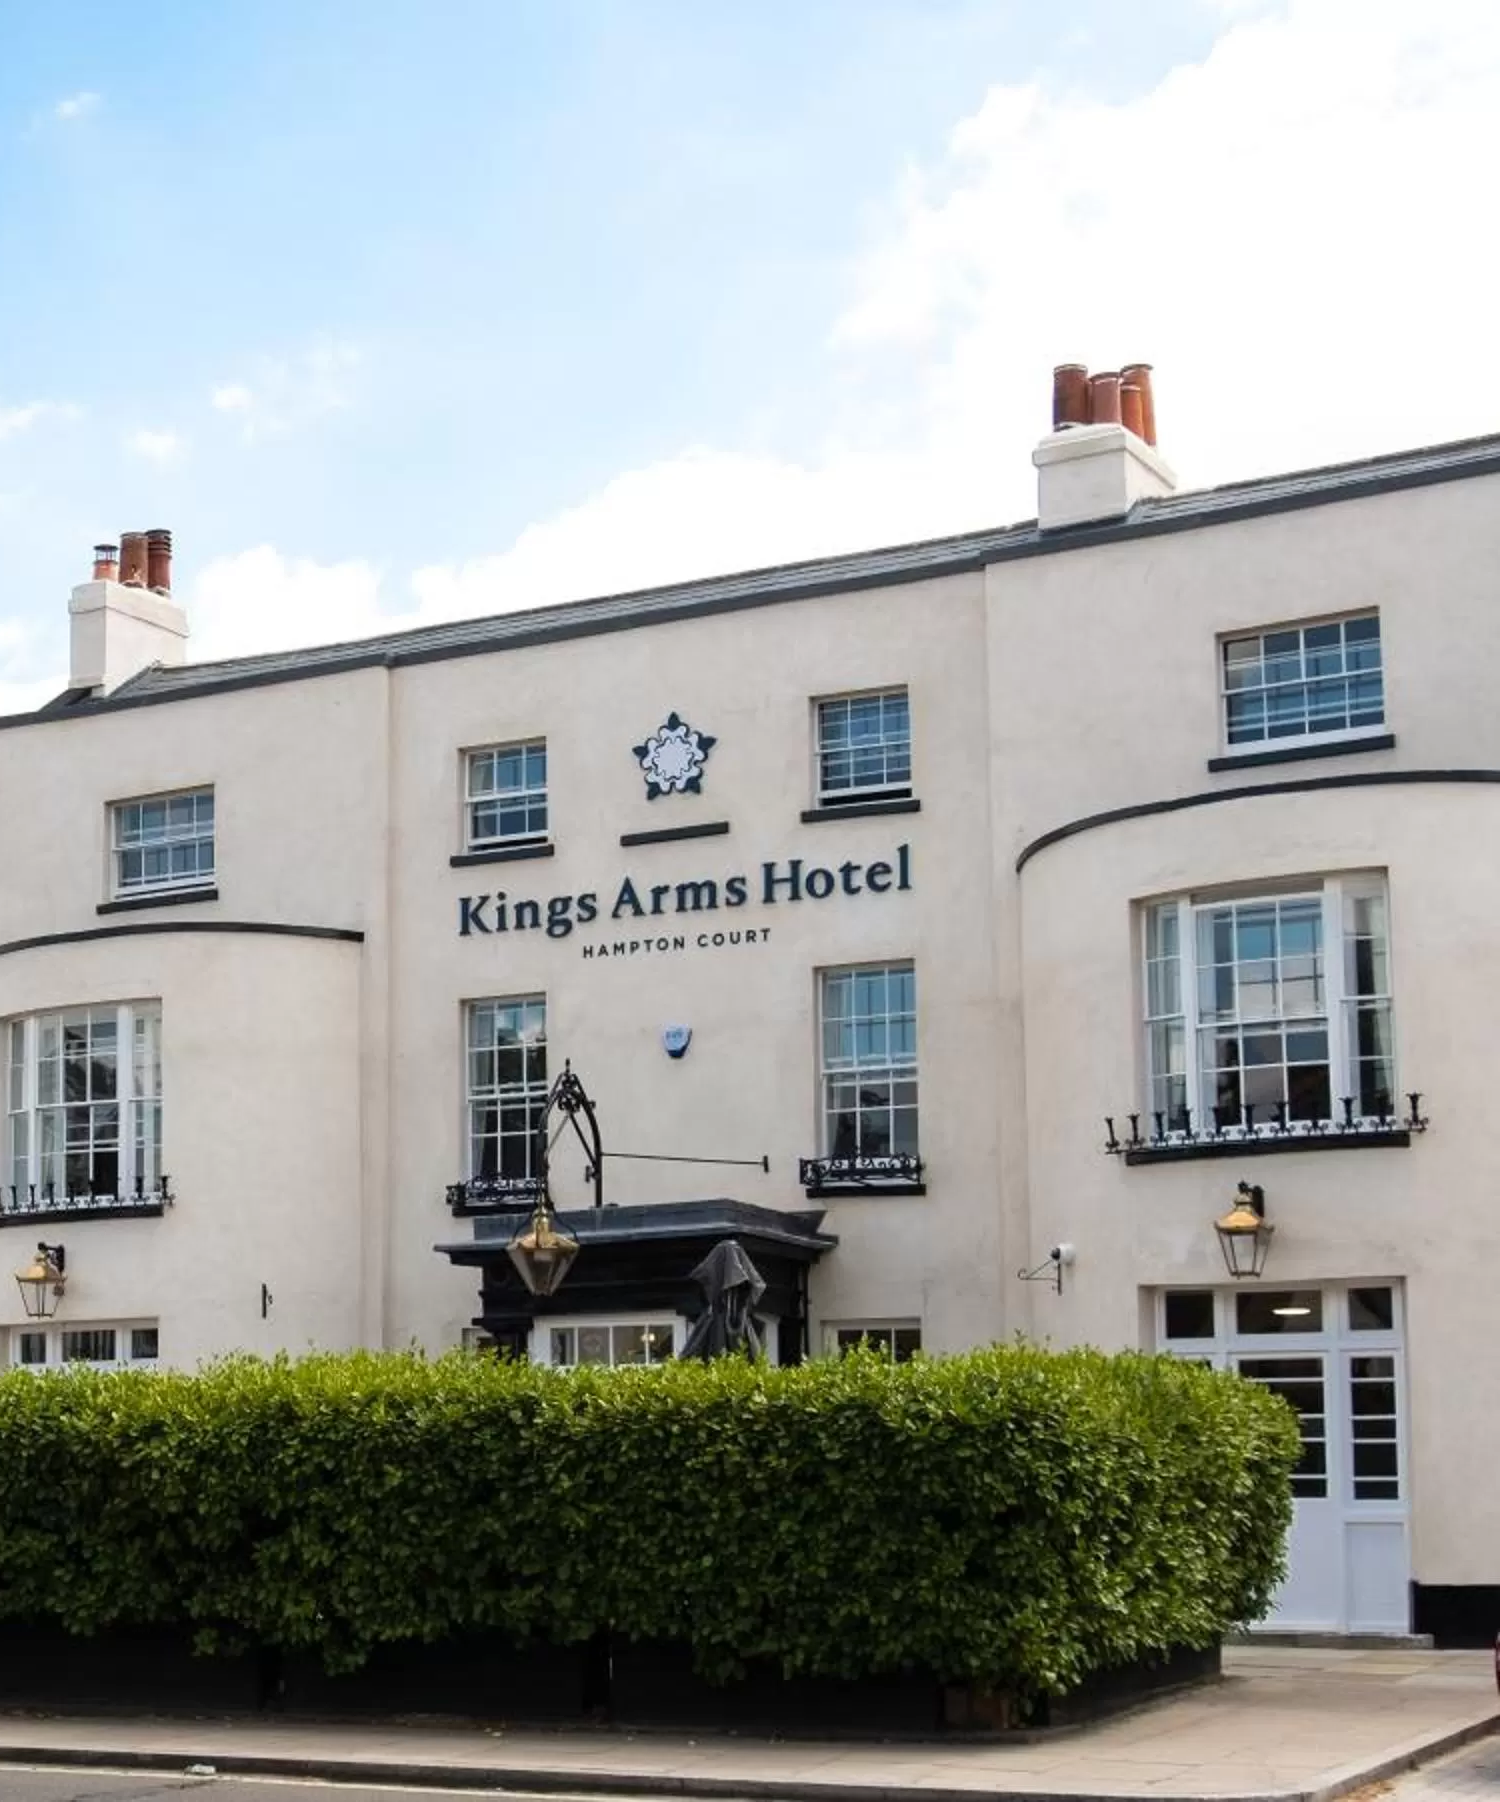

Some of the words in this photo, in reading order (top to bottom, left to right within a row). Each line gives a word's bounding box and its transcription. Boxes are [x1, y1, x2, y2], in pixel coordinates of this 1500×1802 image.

[457, 890, 599, 941] Kings
[609, 875, 749, 921] Arms
[761, 843, 913, 906] Hotel
[581, 934, 686, 960] HAMPTON
[696, 927, 772, 949] COURT
